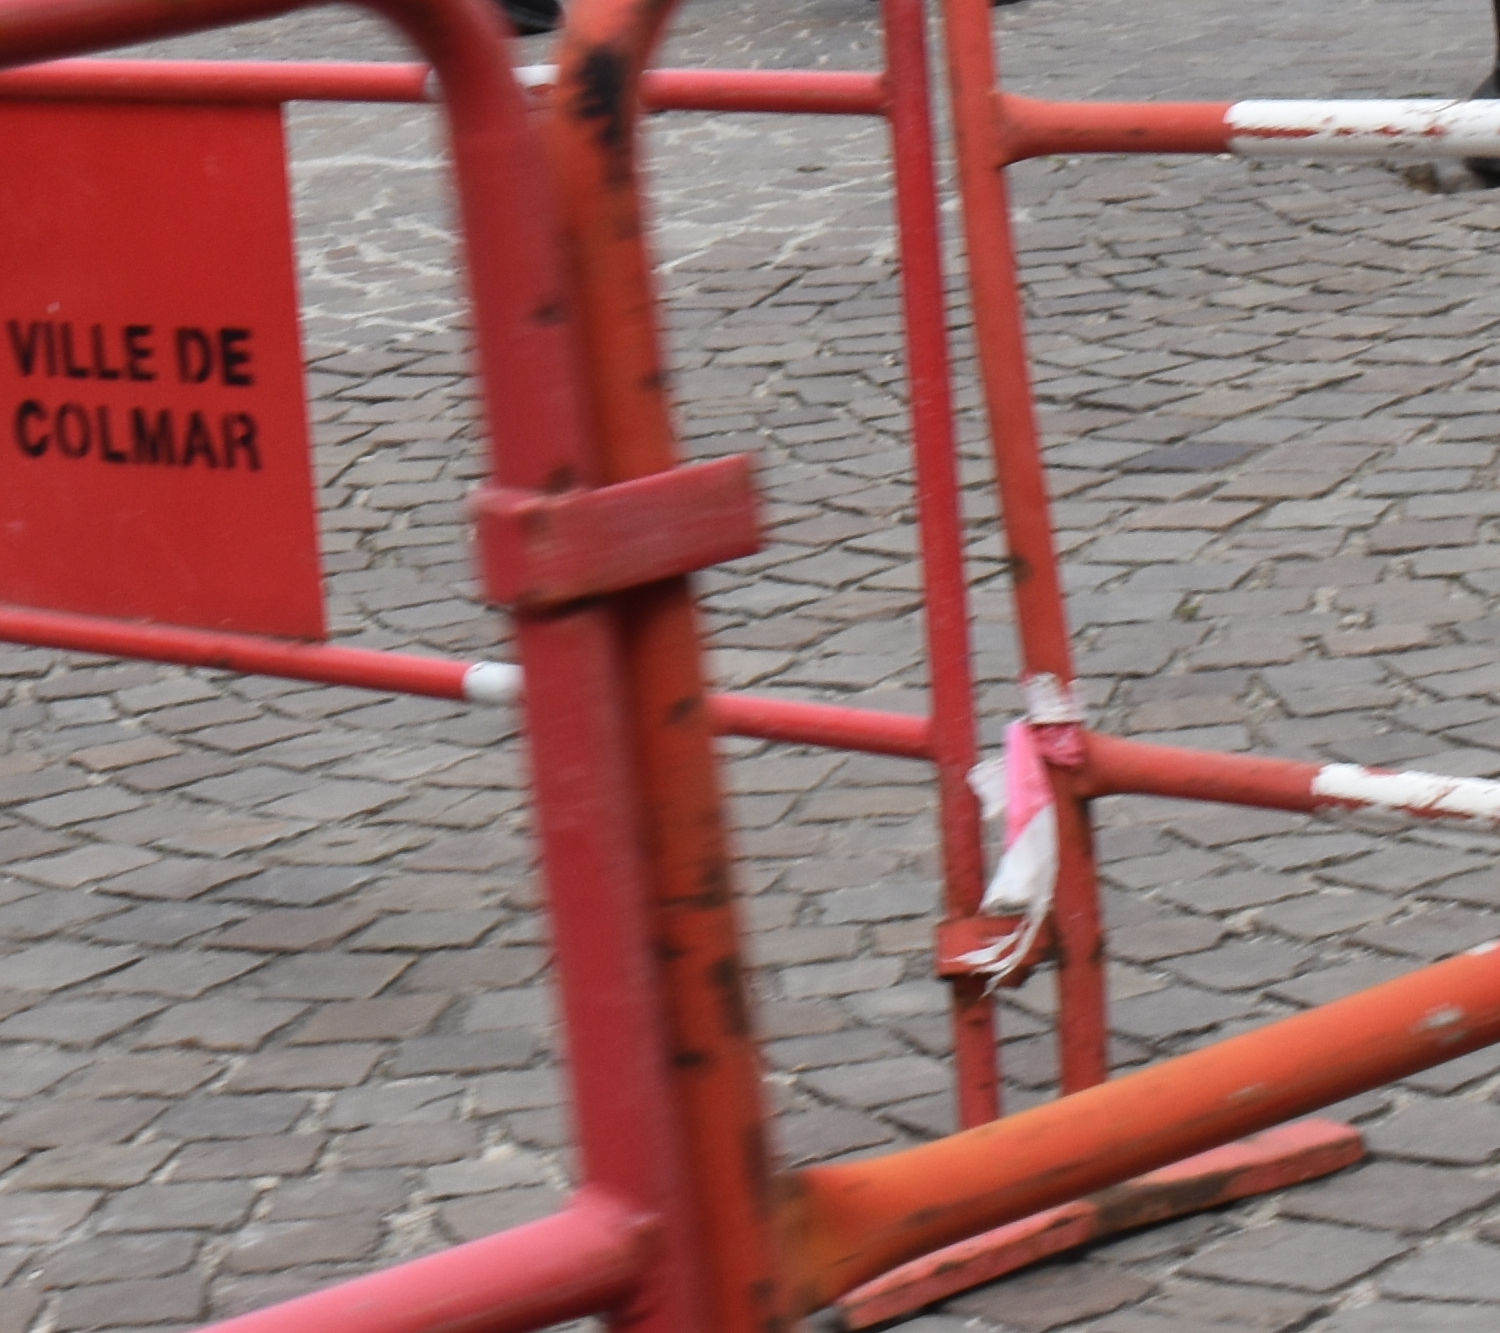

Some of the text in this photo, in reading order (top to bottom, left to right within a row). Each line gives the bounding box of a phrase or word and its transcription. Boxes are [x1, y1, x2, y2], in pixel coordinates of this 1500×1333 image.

[6, 320, 254, 387] VILLE DE
[15, 399, 262, 471] COLMAR
